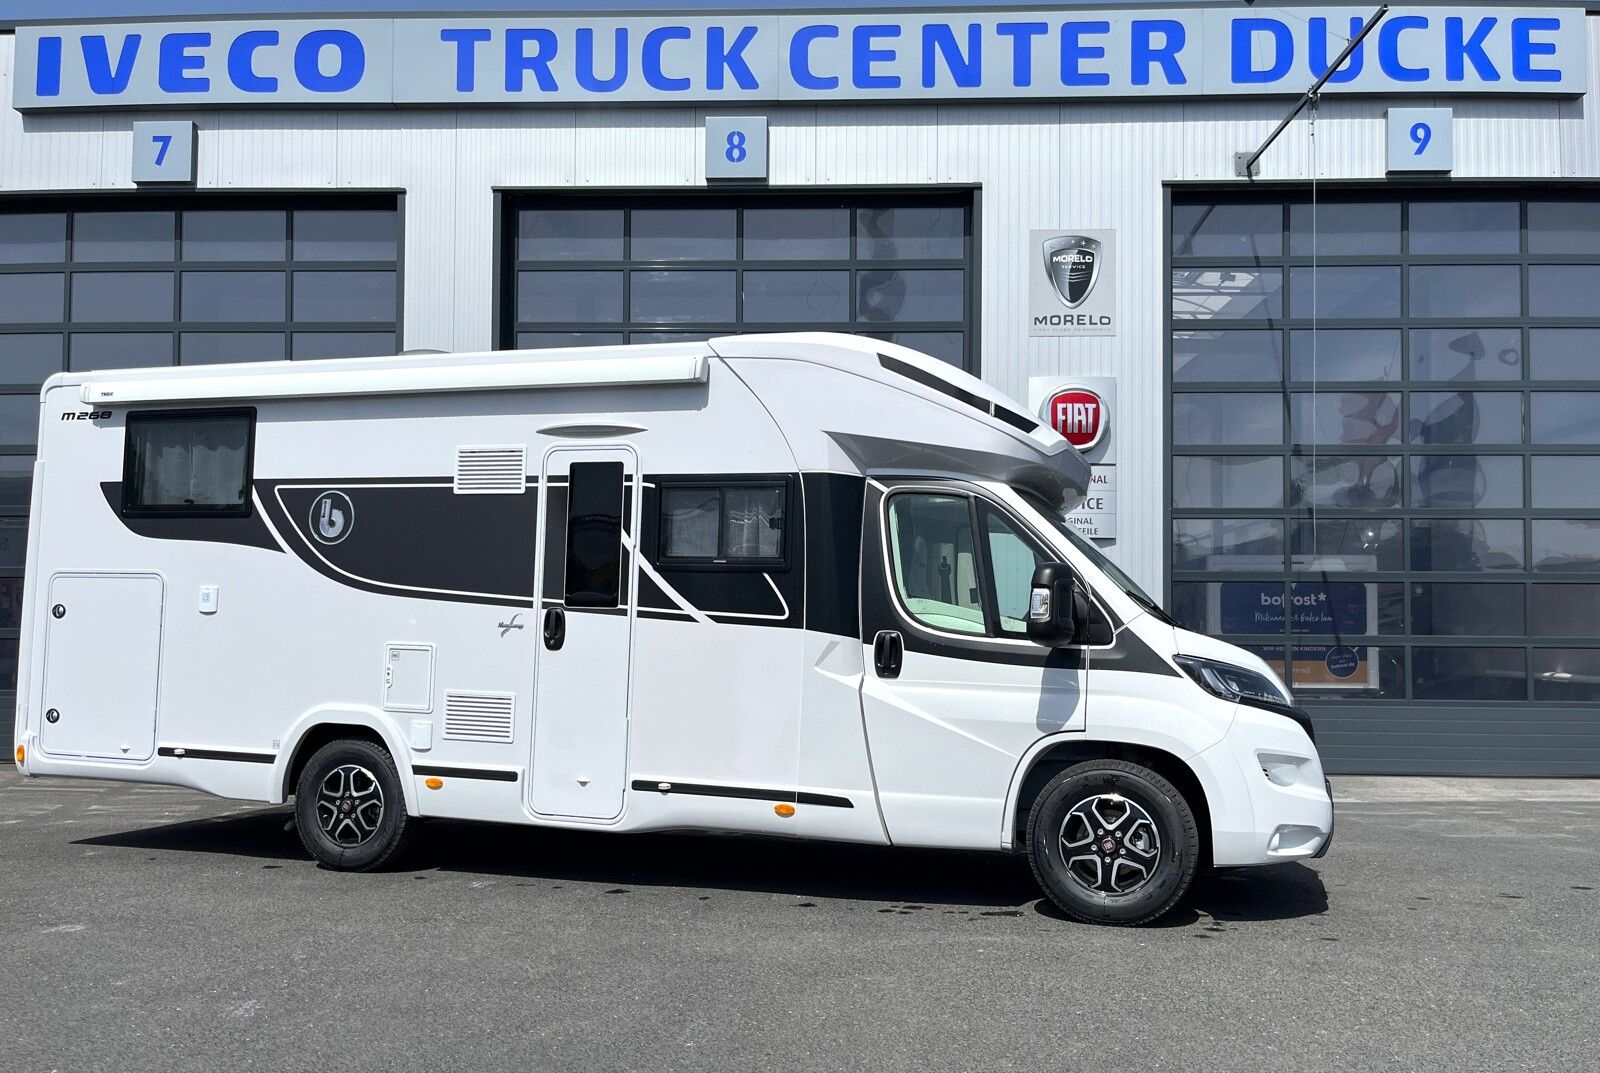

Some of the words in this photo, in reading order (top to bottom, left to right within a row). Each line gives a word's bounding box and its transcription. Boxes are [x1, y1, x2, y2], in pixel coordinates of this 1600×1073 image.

[36, 29, 366, 97] IVECO
[441, 26, 759, 93] TRUCK
[790, 19, 1188, 91] CENTER
[1230, 16, 1563, 85] DUCKE
[152, 134, 172, 166] 7
[725, 131, 747, 163] 8
[1409, 122, 1432, 156] 9
[1052, 254, 1093, 263] MORELO
[1033, 314, 1111, 326] MORELO
[1056, 402, 1097, 433] FIAT
